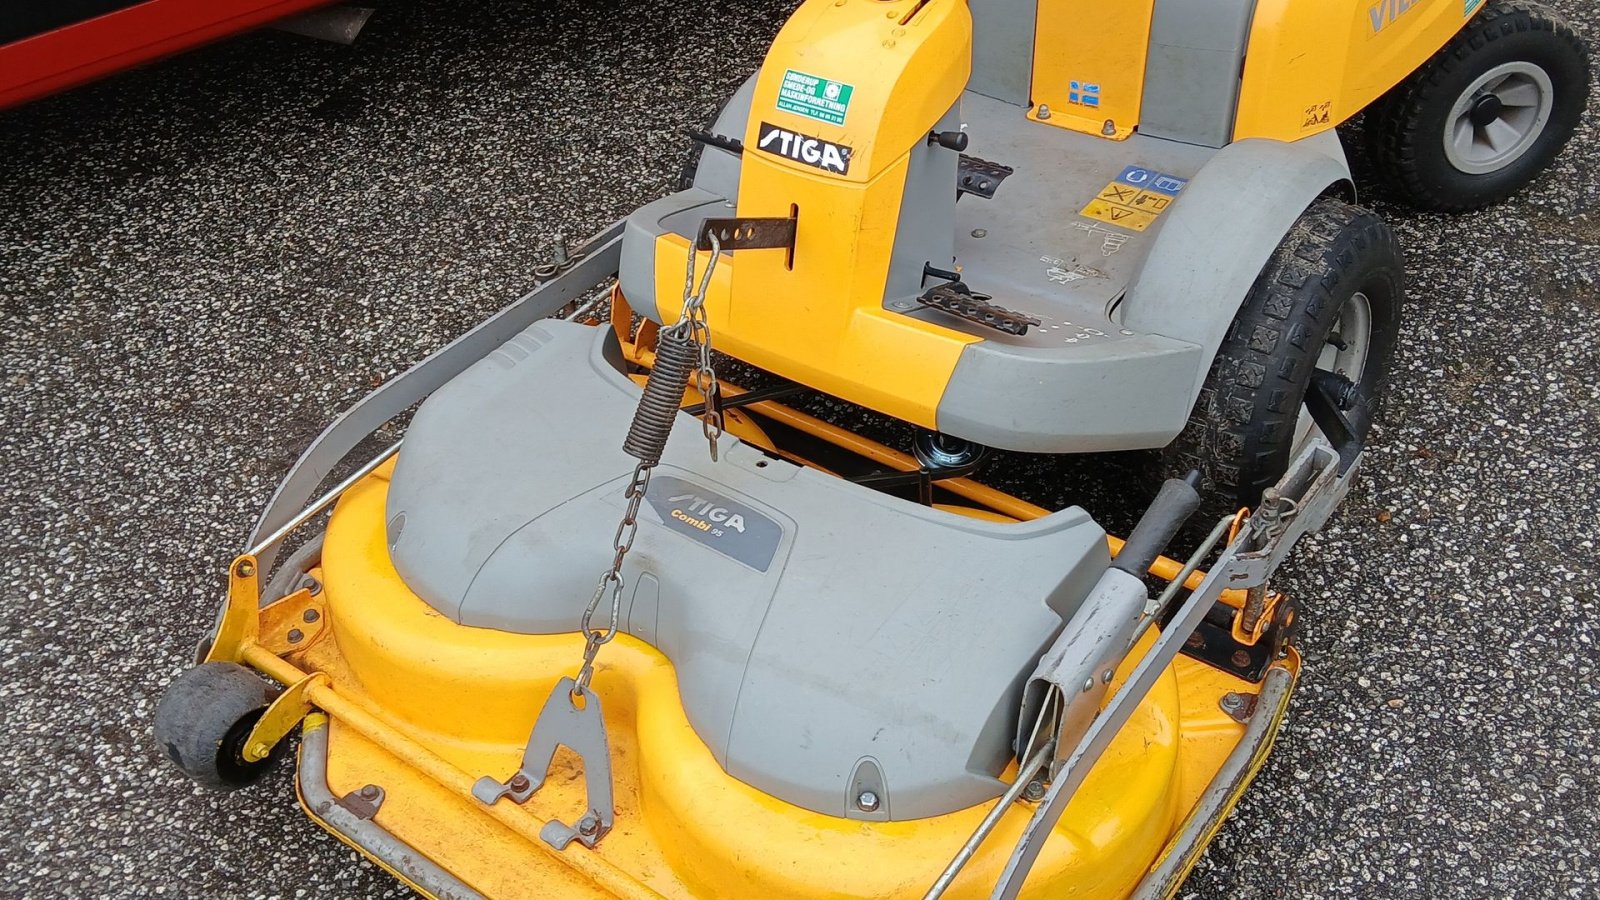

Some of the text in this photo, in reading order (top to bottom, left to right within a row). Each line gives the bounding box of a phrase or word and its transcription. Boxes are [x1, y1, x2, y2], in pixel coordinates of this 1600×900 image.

[786, 72, 820, 87] SØNDERUP
[781, 88, 846, 112] MASKINFORRETNING
[668, 494, 746, 533] STIGA
[671, 509, 724, 537] Combi 95
